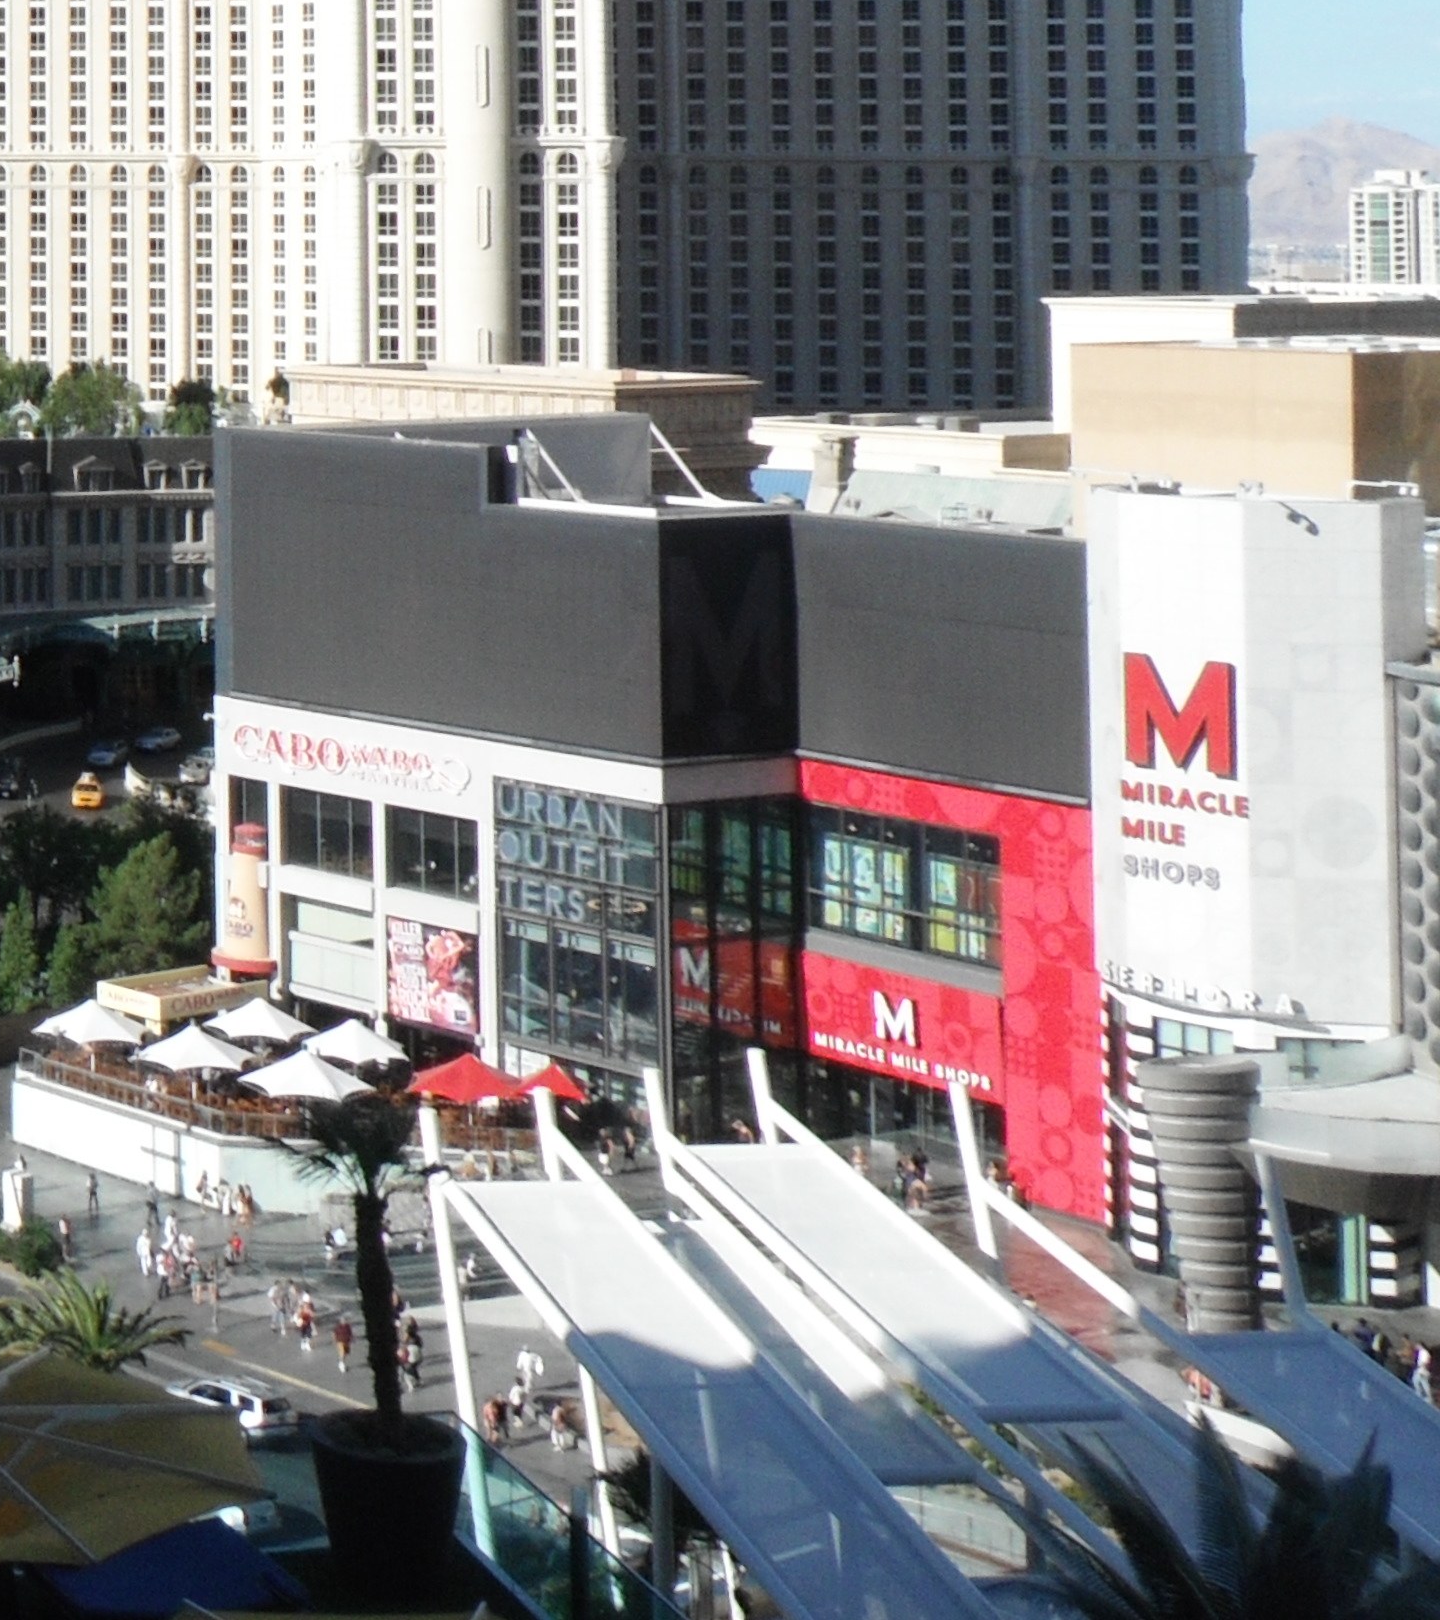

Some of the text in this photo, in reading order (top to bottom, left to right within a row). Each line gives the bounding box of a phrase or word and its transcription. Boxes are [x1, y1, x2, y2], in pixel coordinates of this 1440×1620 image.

[1123, 652, 1238, 781] M
[233, 724, 347, 776] CABO
[498, 781, 624, 840] URBAN
[1120, 779, 1251, 820] MIRACLE
[498, 830, 630, 885] OUTFIT
[1121, 815, 1187, 848] MILE
[497, 874, 587, 923] TERS
[1122, 853, 1222, 892] SHOPS
[172, 993, 216, 1013] CABO
[1101, 959, 1298, 1017] SEPHORA
[873, 989, 919, 1049] M
[813, 1030, 992, 1092] MIRACLE MILE SHOPS
